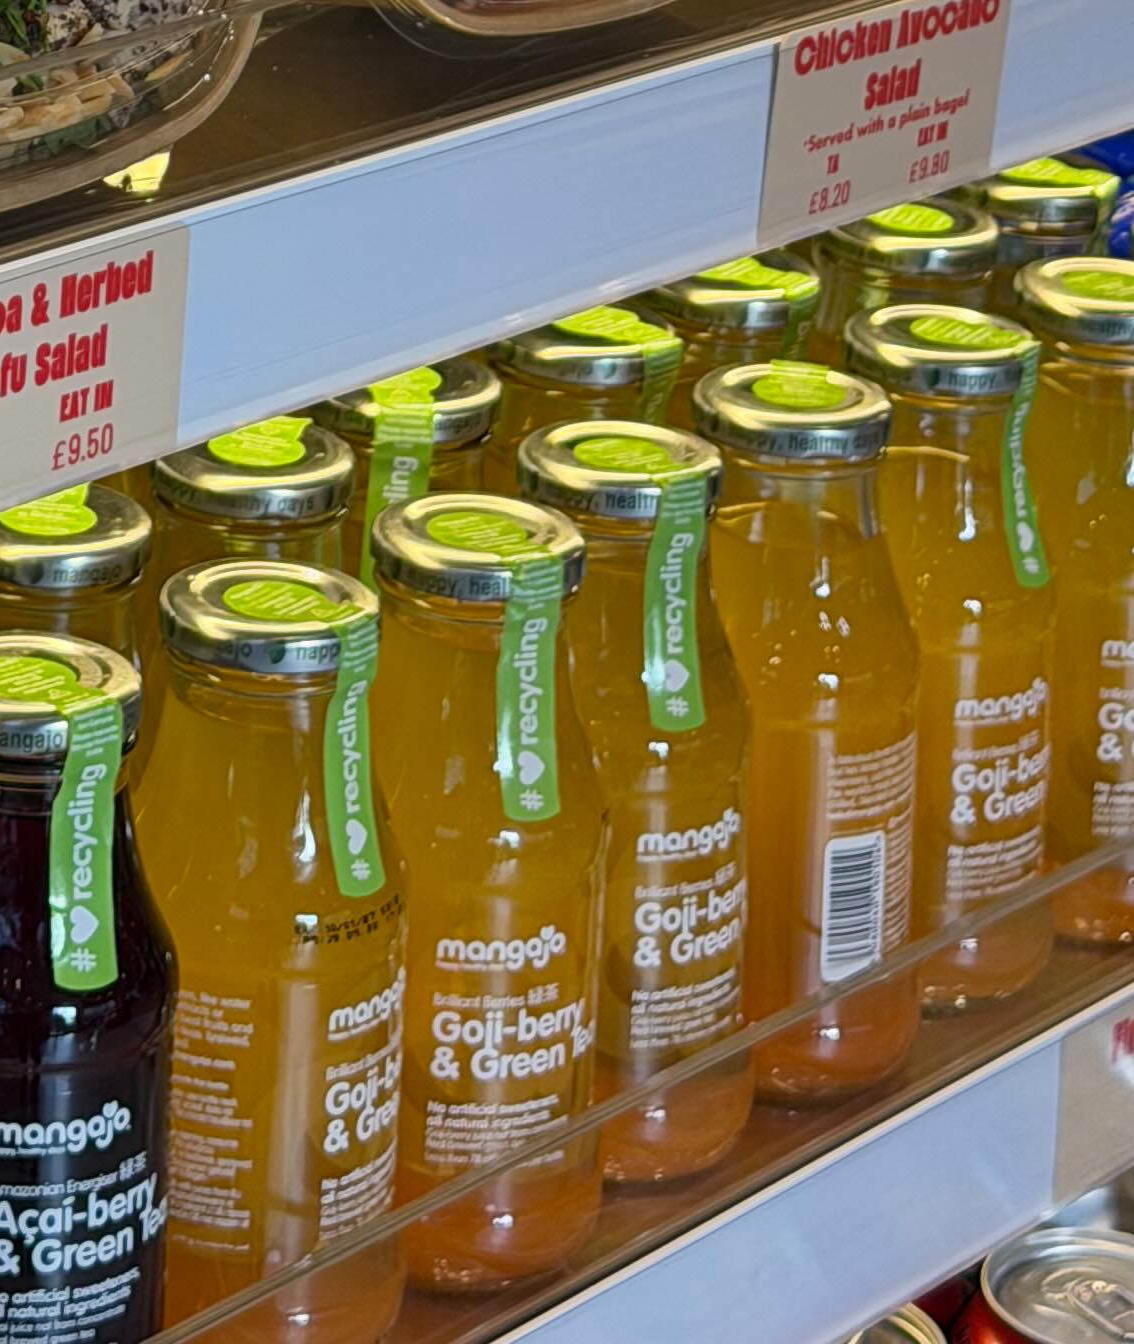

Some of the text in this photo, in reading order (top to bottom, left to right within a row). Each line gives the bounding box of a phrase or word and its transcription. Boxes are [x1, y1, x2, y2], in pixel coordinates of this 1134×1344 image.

[794, 19, 892, 76] Chicken
[864, 58, 922, 111] Salad
[857, 113, 884, 138] with
[888, 115, 896, 128] a
[898, 104, 930, 131] plain
[934, 89, 970, 115] bagel
[809, 180, 851, 215] £8.20
[31, 283, 50, 326] &
[60, 250, 154, 318] Herbed
[34, 323, 108, 387] Salad
[60, 379, 114, 422] EAT IN
[51, 422, 114, 470] £9.50
[469, 574, 508, 597] heal
[660, 531, 694, 655] recycling
[296, 641, 341, 666] happ
[513, 617, 547, 747] recycling
[337, 679, 367, 814] recycling
[68, 762, 107, 901] recycling
[637, 807, 741, 856] mangajo
[950, 793, 975, 824] &
[436, 925, 566, 971] mangajo
[634, 918, 741, 967] & Green
[432, 997, 586, 1049] Goji-berry
[430, 1046, 460, 1080] &
[470, 1043, 566, 1080] Green
[324, 1118, 349, 1153] &
[31, 1226, 134, 1273] Green
